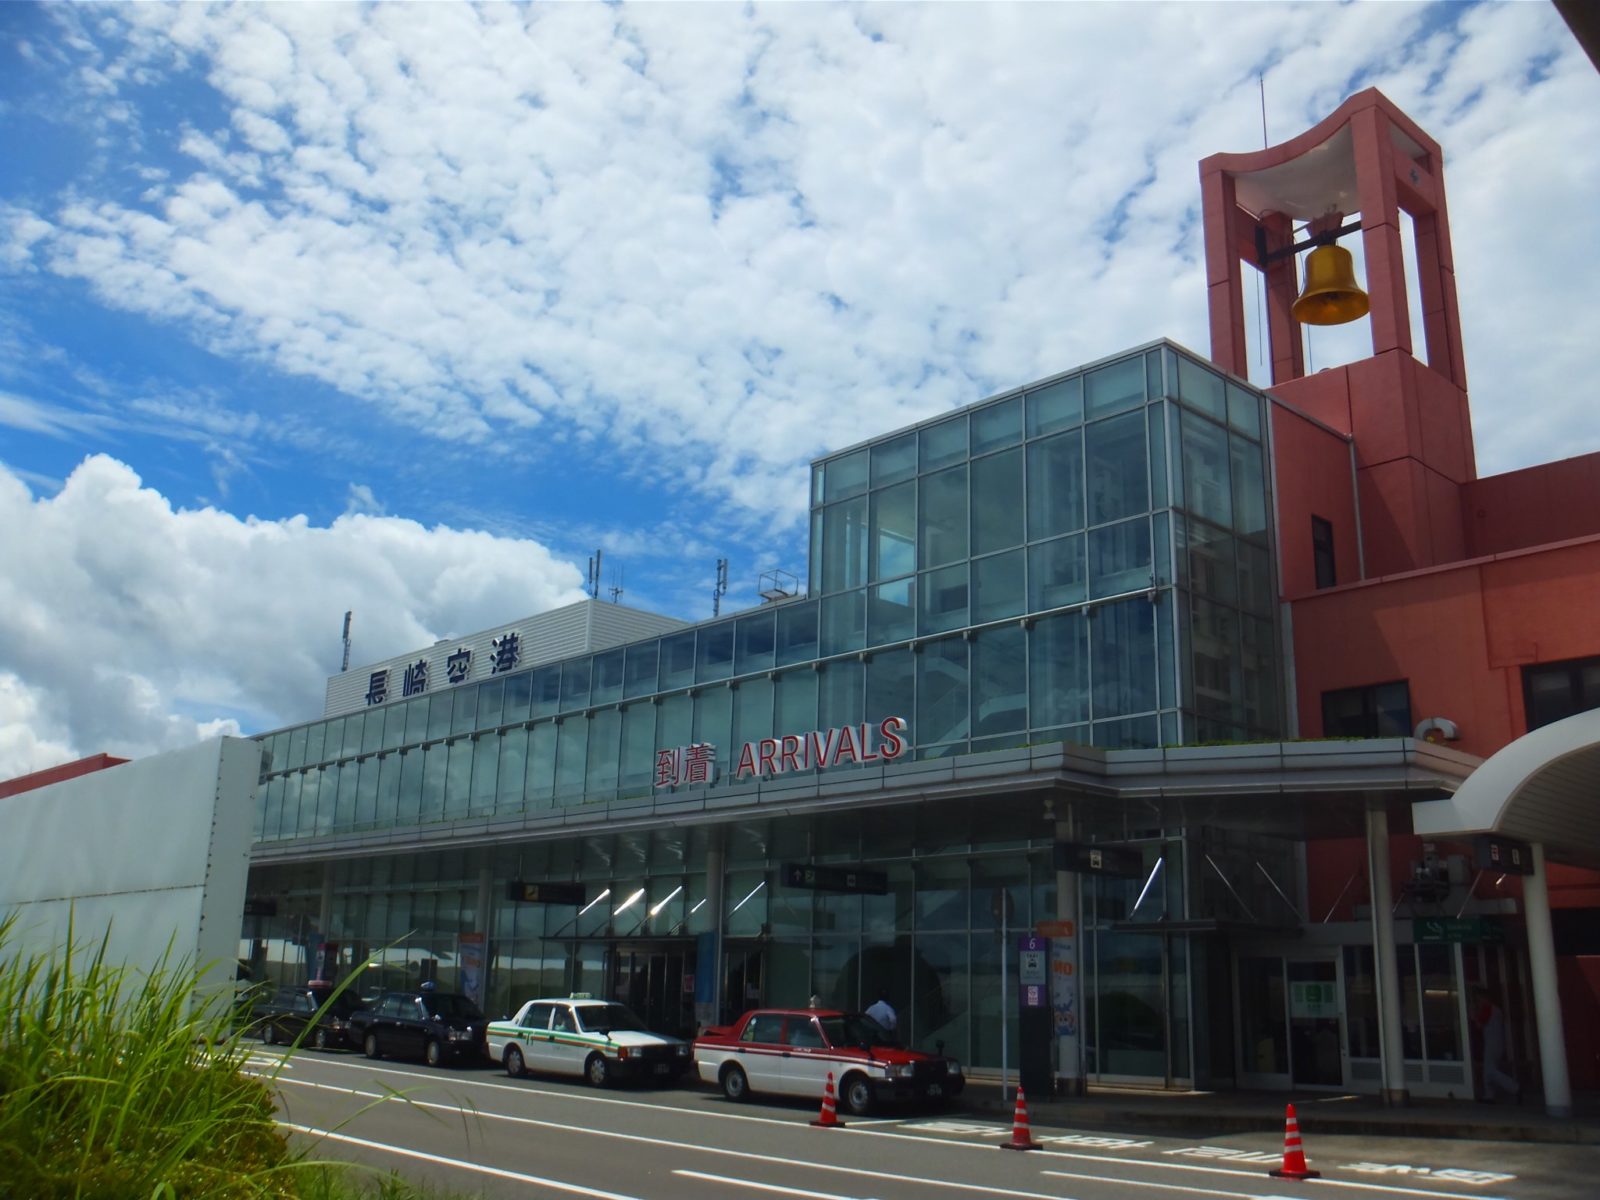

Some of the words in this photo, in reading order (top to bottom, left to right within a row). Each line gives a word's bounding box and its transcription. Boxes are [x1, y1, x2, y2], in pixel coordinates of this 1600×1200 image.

[365, 632, 521, 706] 長崎空港
[655, 743, 715, 788] 到着
[736, 716, 907, 780] ARRIVALS
[1029, 938, 1036, 950] 6
